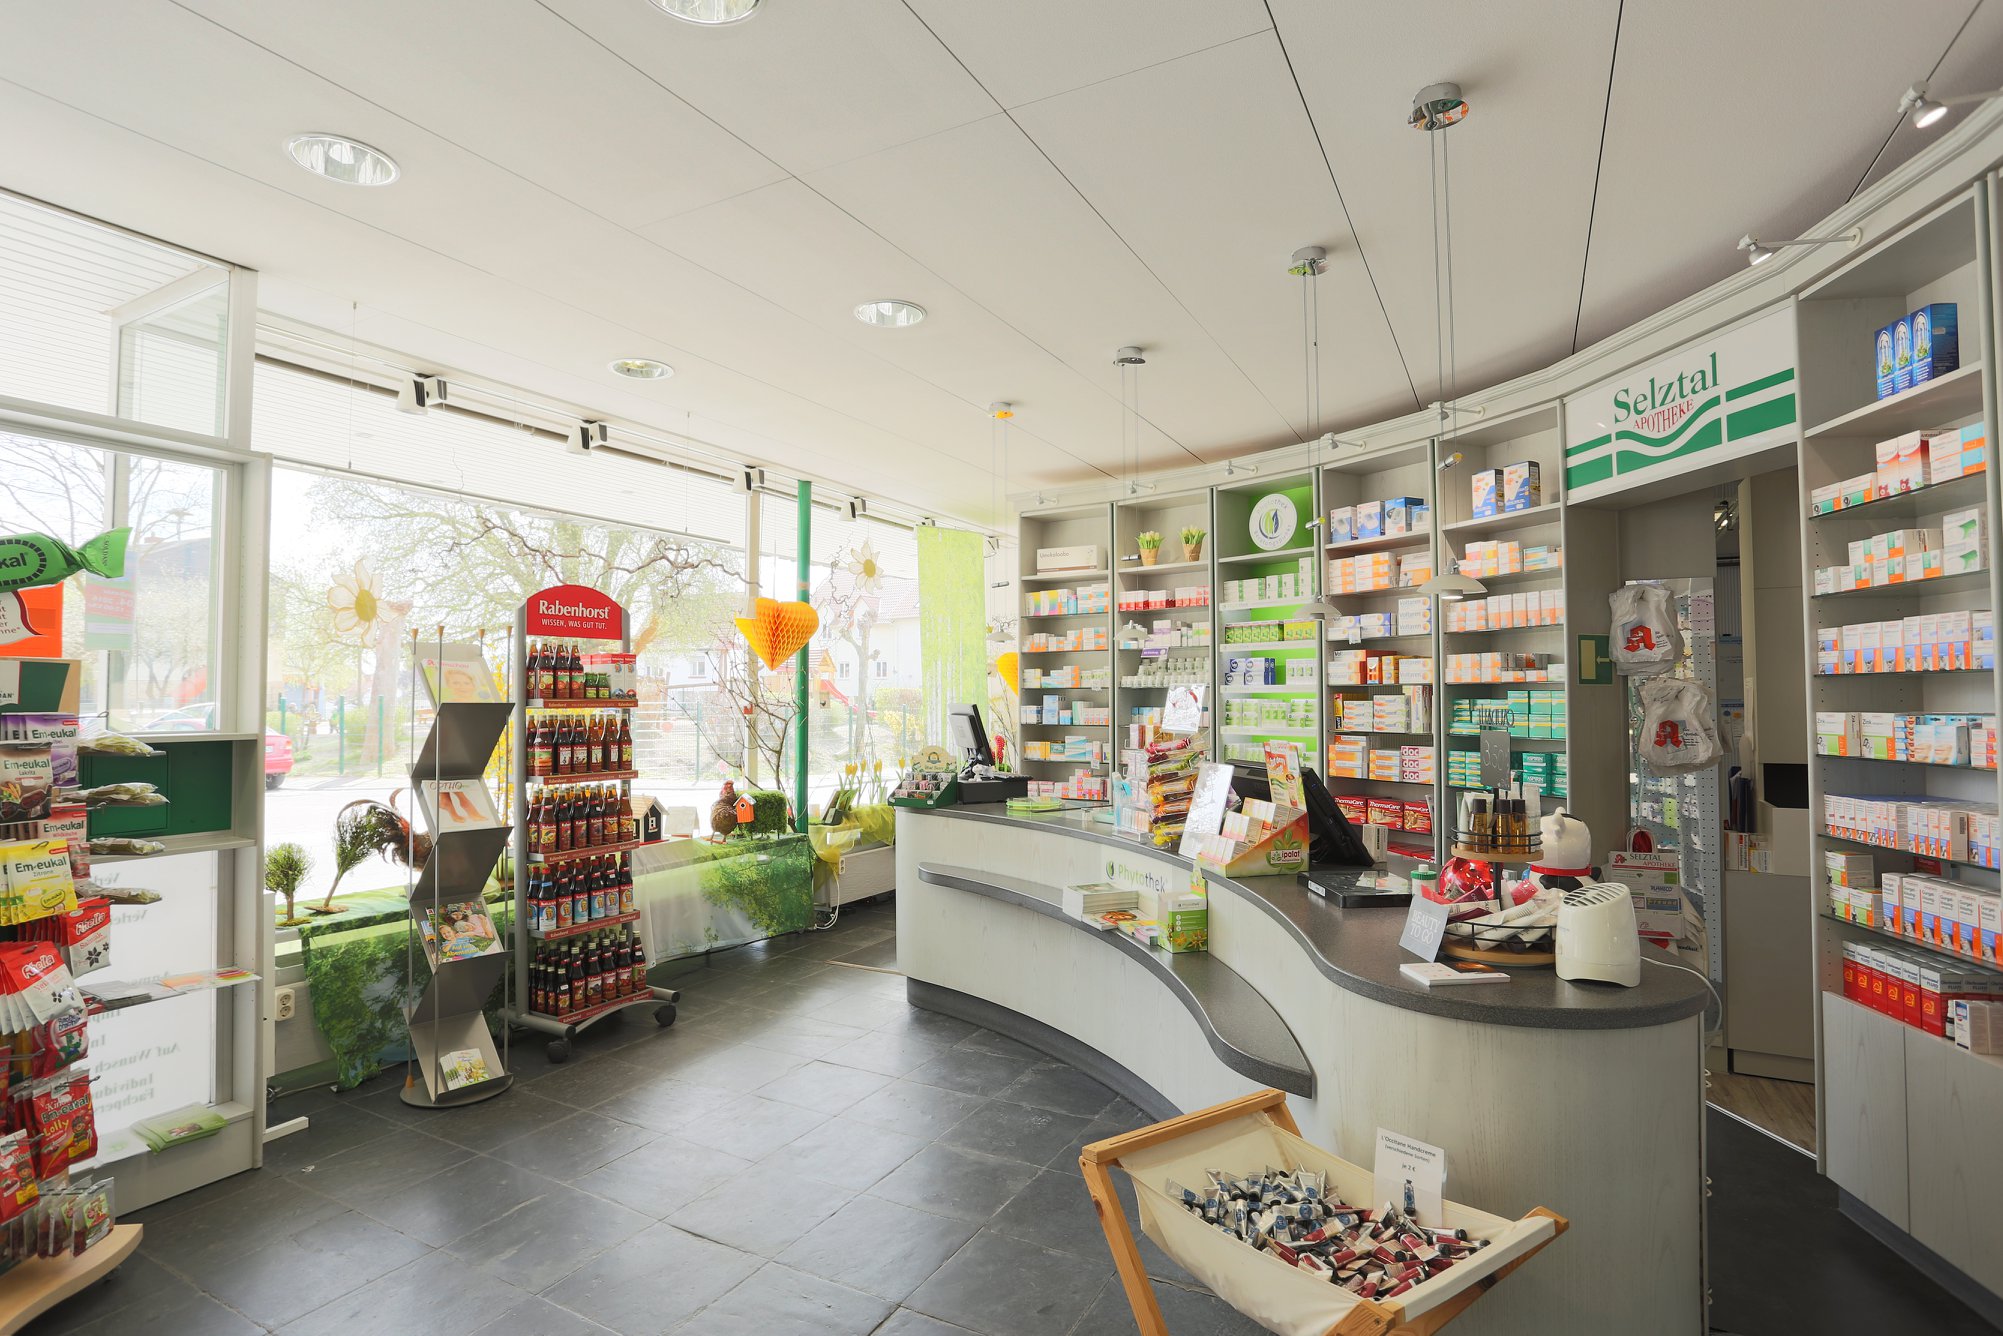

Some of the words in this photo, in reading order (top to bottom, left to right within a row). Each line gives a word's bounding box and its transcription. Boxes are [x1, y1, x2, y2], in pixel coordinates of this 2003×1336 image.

[1614, 352, 1720, 424] Selztal
[1633, 399, 1695, 433] APOTHEKE
[539, 600, 609, 620] Rabenhorst
[542, 618, 567, 627] WISSEN,
[568, 620, 581, 628] WAS
[582, 621, 594, 629] GUT
[595, 622, 607, 630] TUT.
[32, 728, 76, 739] Em-eukal
[1402, 747, 1419, 756] doc
[4, 758, 50, 770] Em-eukal
[1402, 759, 1419, 768] doc
[1403, 771, 1419, 780] doc
[1335, 797, 1364, 806] ThermaCare
[1369, 801, 1401, 810] ThermaCare
[43, 820, 84, 833] Em-eukal
[1281, 850, 1300, 859] ipalat
[1630, 853, 1662, 861] SELZTAL
[15, 857, 67, 873] Em-eukal
[1643, 860, 1675, 868] APOTHEKE
[1118, 864, 1165, 893] Phytothek
[1412, 909, 1441, 933] BEAUTY
[1410, 923, 1420, 938] TO
[1421, 929, 1434, 944] GO
[43, 1119, 70, 1136] Lolly
[1407, 1144, 1436, 1157] Handcreme
